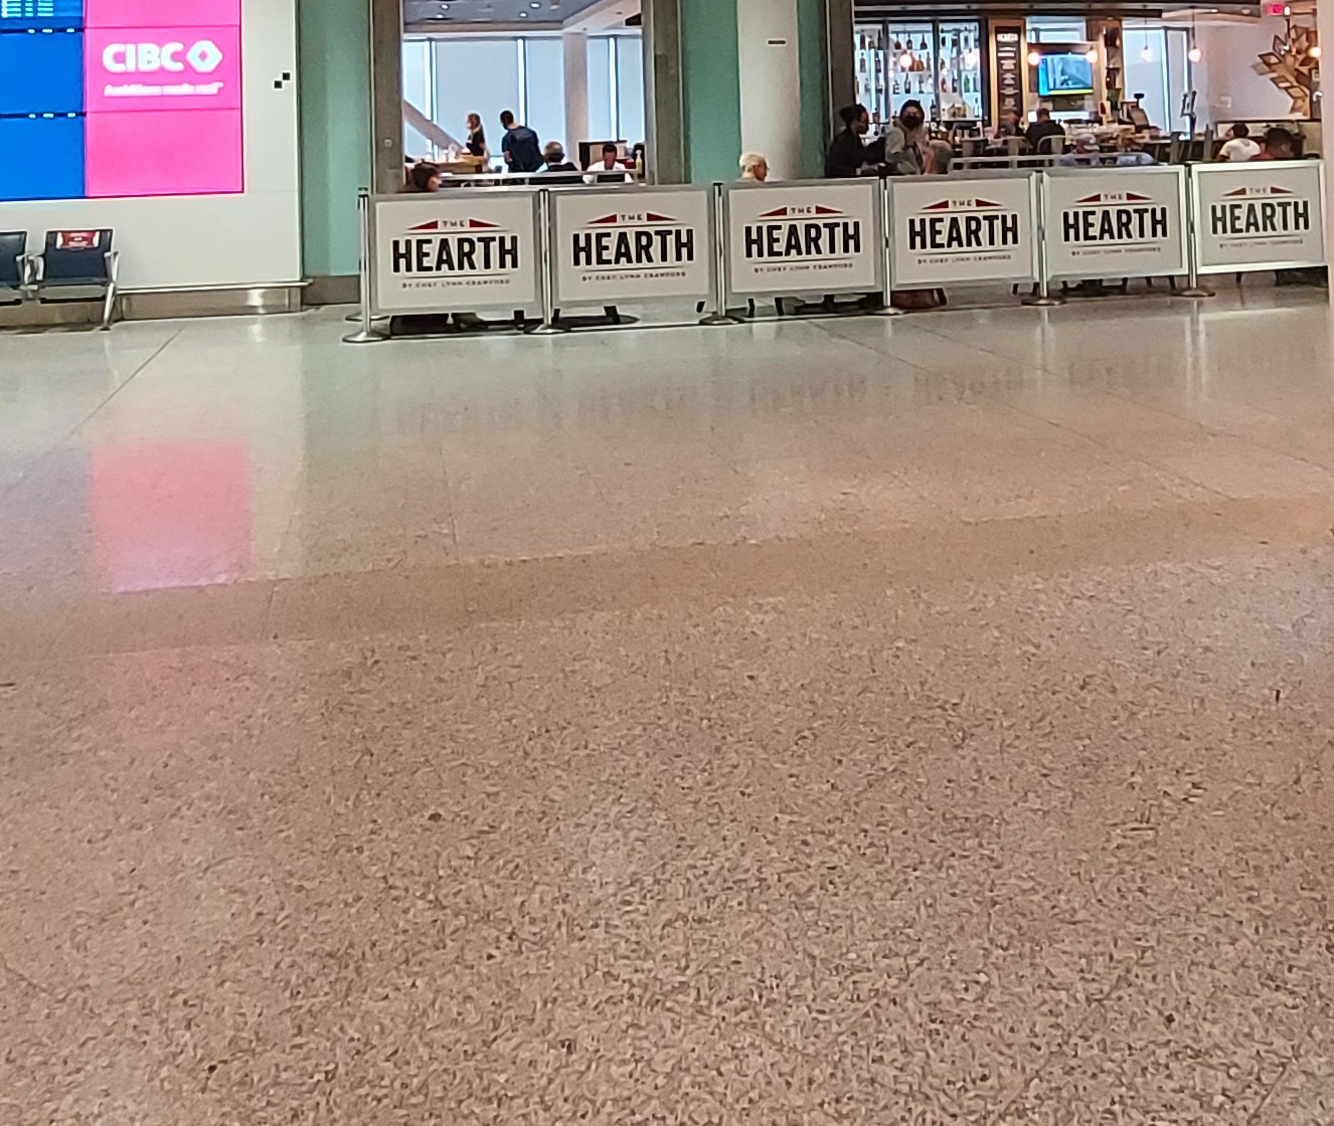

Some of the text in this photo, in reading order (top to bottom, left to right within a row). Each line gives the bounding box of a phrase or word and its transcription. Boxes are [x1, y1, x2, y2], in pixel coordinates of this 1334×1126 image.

[102, 41, 185, 73] CIBC
[441, 219, 466, 228] THE
[620, 213, 643, 222] THE
[790, 206, 812, 214] THE
[1062, 206, 1168, 242] HEARTH
[1212, 200, 1310, 235] HEARTH
[572, 228, 694, 267] HEARTH
[744, 220, 861, 259] HEARTH
[908, 213, 1019, 250] HEARTH
[392, 235, 519, 273] HEARTH
